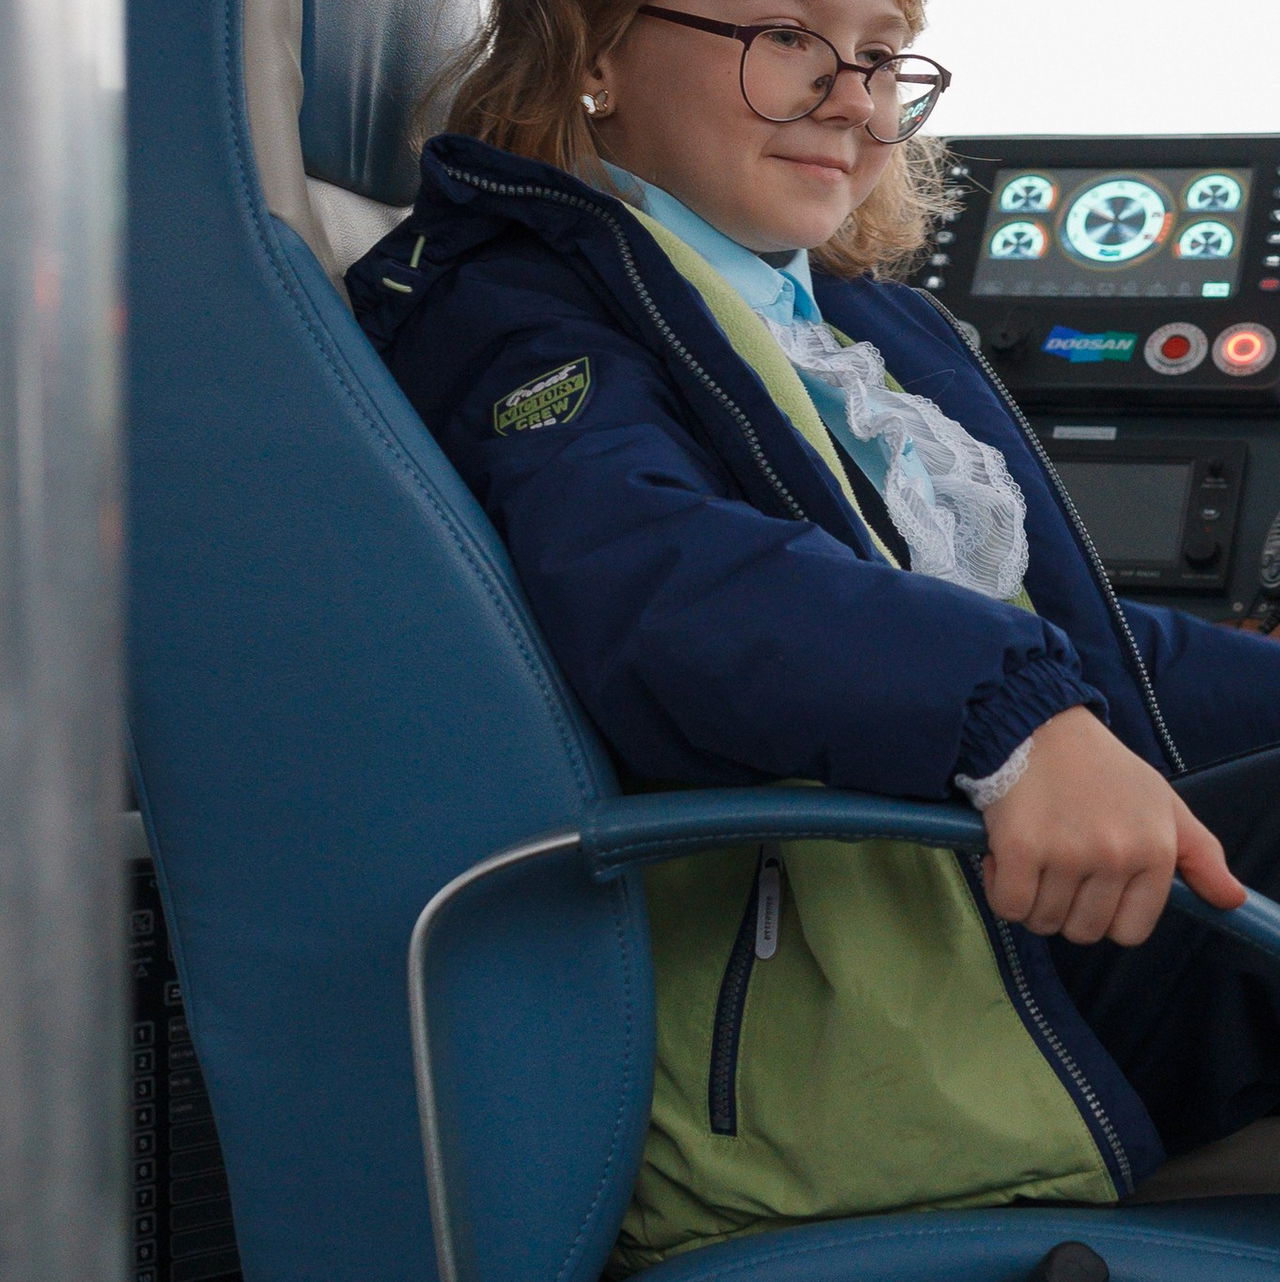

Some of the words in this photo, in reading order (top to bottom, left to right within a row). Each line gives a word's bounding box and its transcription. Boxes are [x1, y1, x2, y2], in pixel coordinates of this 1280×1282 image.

[1045, 338, 1134, 350] DOOSAN
[504, 377, 579, 420] VICTORY
[515, 397, 569, 430] CREW
